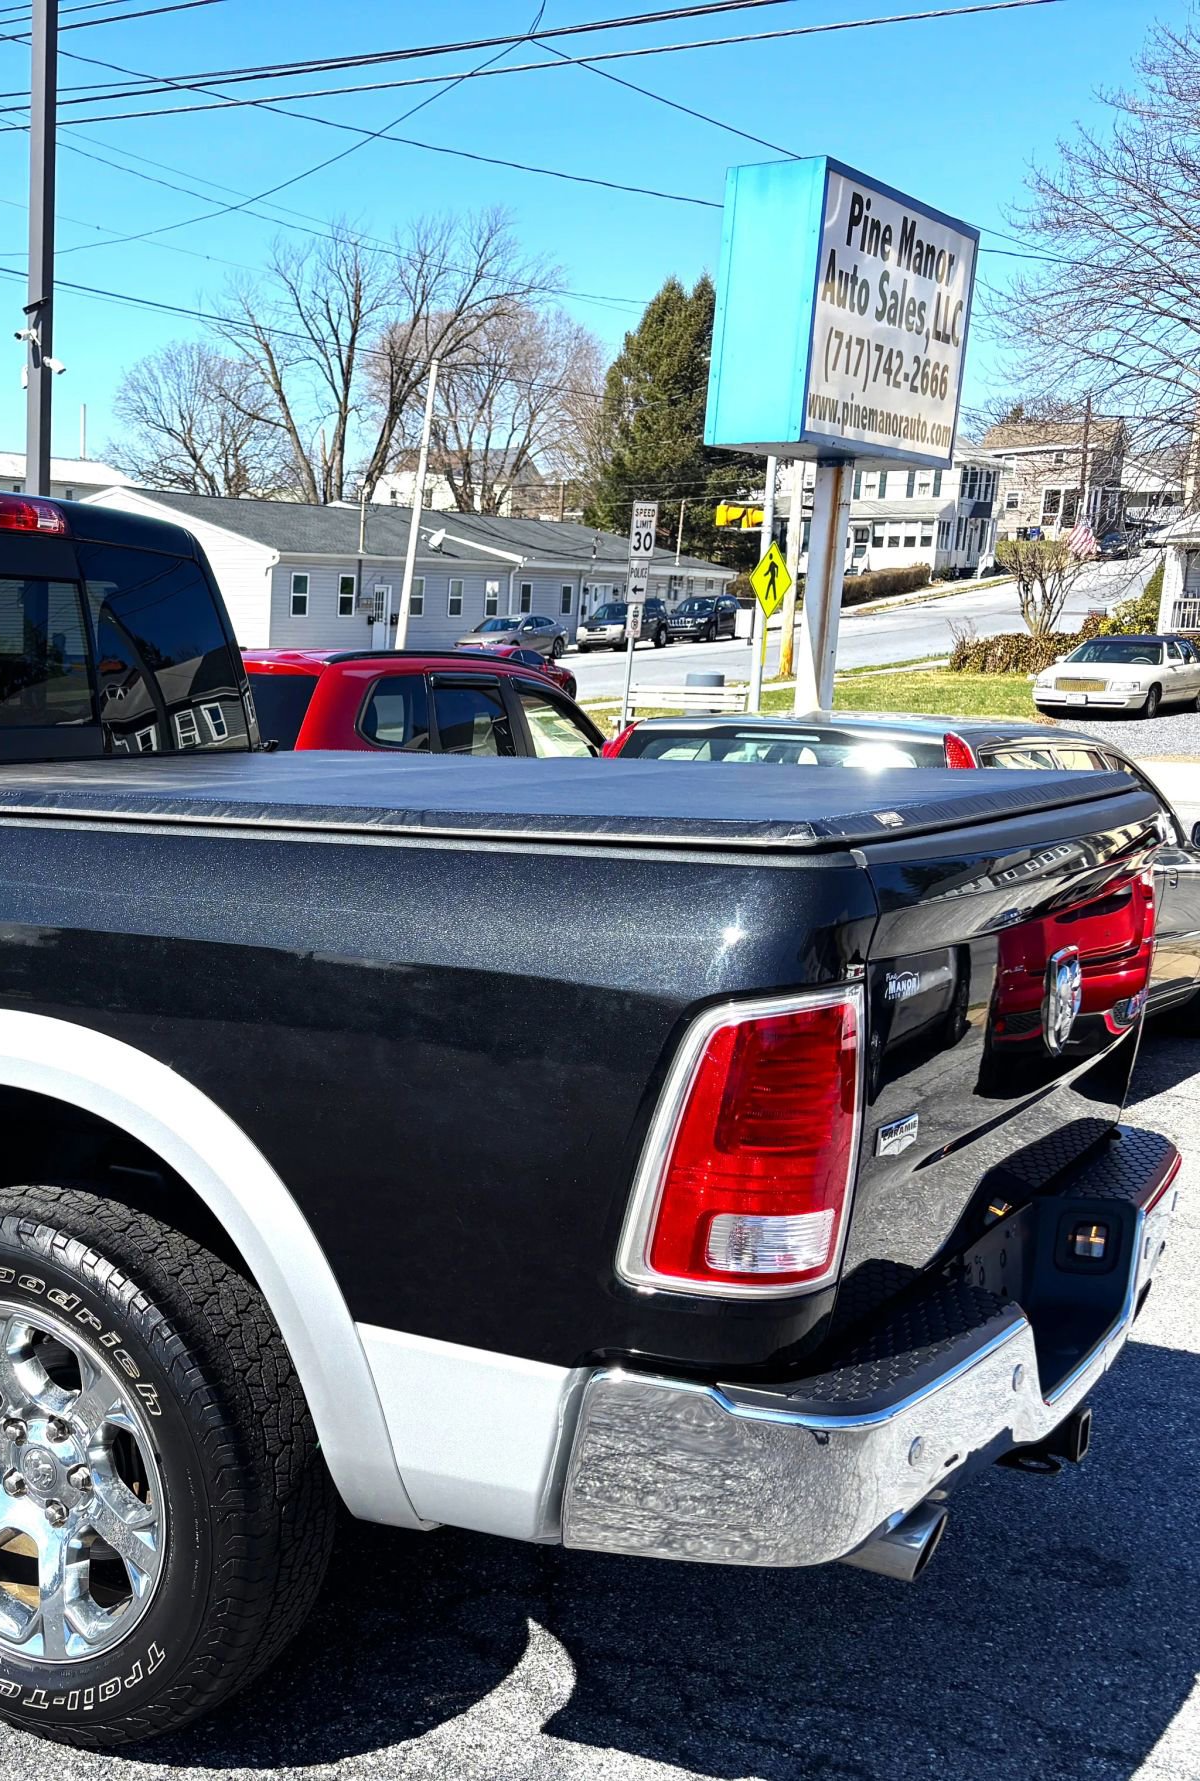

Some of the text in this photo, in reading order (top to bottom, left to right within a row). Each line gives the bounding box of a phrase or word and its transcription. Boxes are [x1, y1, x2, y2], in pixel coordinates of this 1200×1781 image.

[846, 191, 955, 287] Pine Manor
[821, 249, 870, 317] Auto
[808, 392, 952, 449] www.pinemanorauto.com
[635, 508, 656, 518] SPEED
[635, 520, 653, 529] LIMIT
[633, 531, 653, 552] 30
[630, 567, 648, 579] POLICE
[888, 977, 918, 995] MANOR
[881, 1119, 918, 1141] LARAMIE
